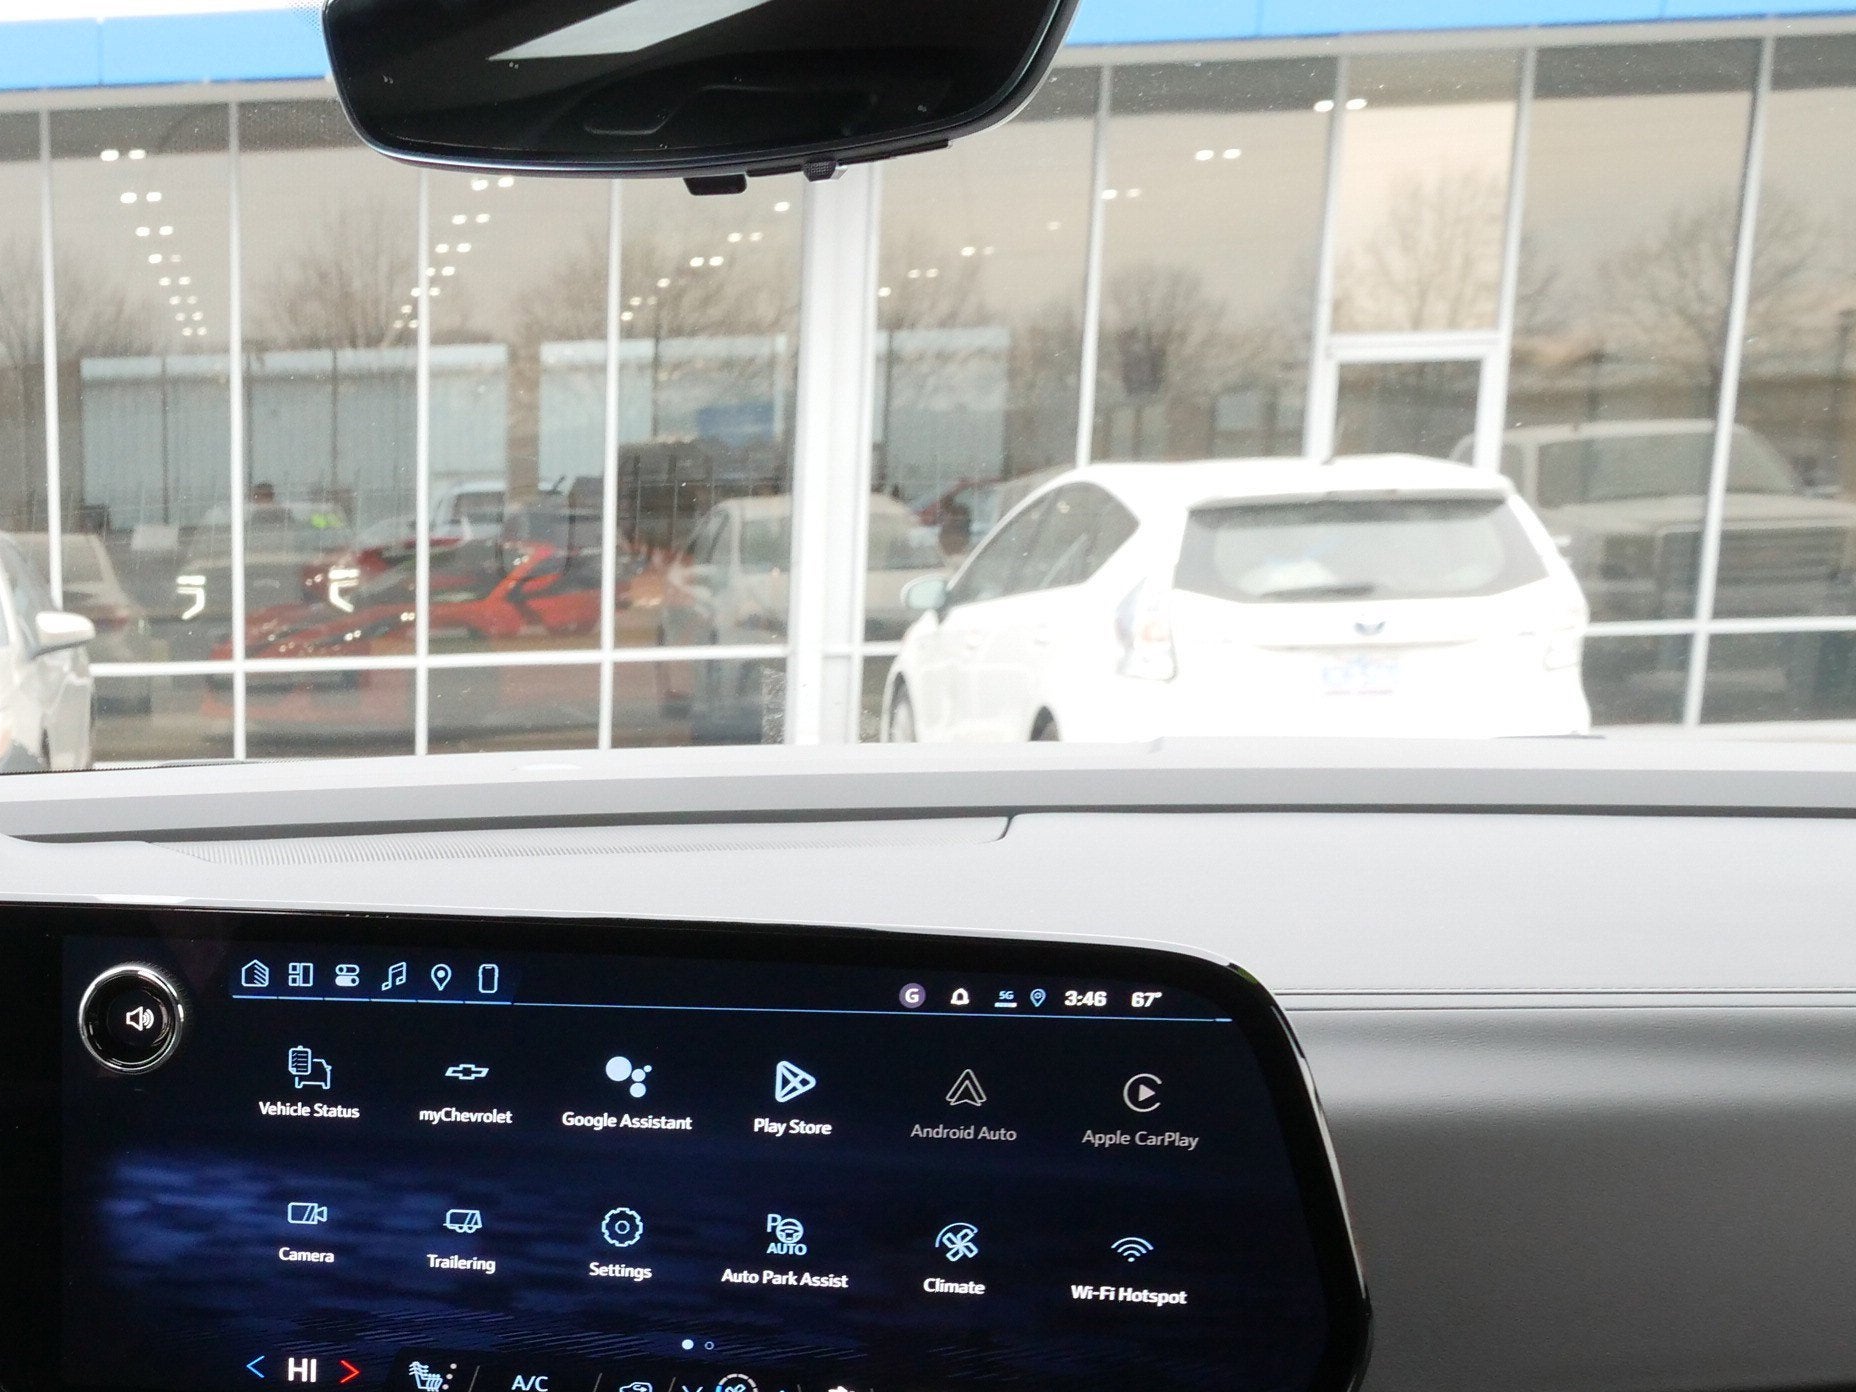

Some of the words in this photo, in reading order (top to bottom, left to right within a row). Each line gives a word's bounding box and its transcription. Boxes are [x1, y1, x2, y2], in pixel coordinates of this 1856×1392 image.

[998, 990, 1015, 1000] 5G
[1064, 990, 1107, 1007] 3:46
[1131, 991, 1163, 1008] 67°
[258, 1101, 311, 1117] Vehicle
[313, 1103, 361, 1119] Status
[419, 1107, 513, 1125] myChevrolet
[561, 1111, 618, 1131] Google
[619, 1113, 693, 1130] Assistant
[753, 1118, 787, 1137] Play
[789, 1119, 833, 1135] Store
[910, 1124, 974, 1140] Android
[977, 1126, 1017, 1141] Auto
[1082, 1130, 1131, 1148] Apple
[1135, 1131, 1200, 1151] CarPlay
[278, 1246, 335, 1263] Camera
[766, 1242, 808, 1256] AUTO
[426, 1253, 496, 1275] Trailering
[588, 1261, 653, 1282] Settings
[721, 1268, 759, 1284] Auto
[762, 1270, 798, 1286] Park
[799, 1272, 849, 1288] Assist
[923, 1277, 986, 1295] Climate
[1070, 1284, 1116, 1301] Wi-Fi
[1118, 1286, 1188, 1307] Hotspot
[287, 1357, 317, 1383] HI
[511, 1374, 549, 1392] A/C
